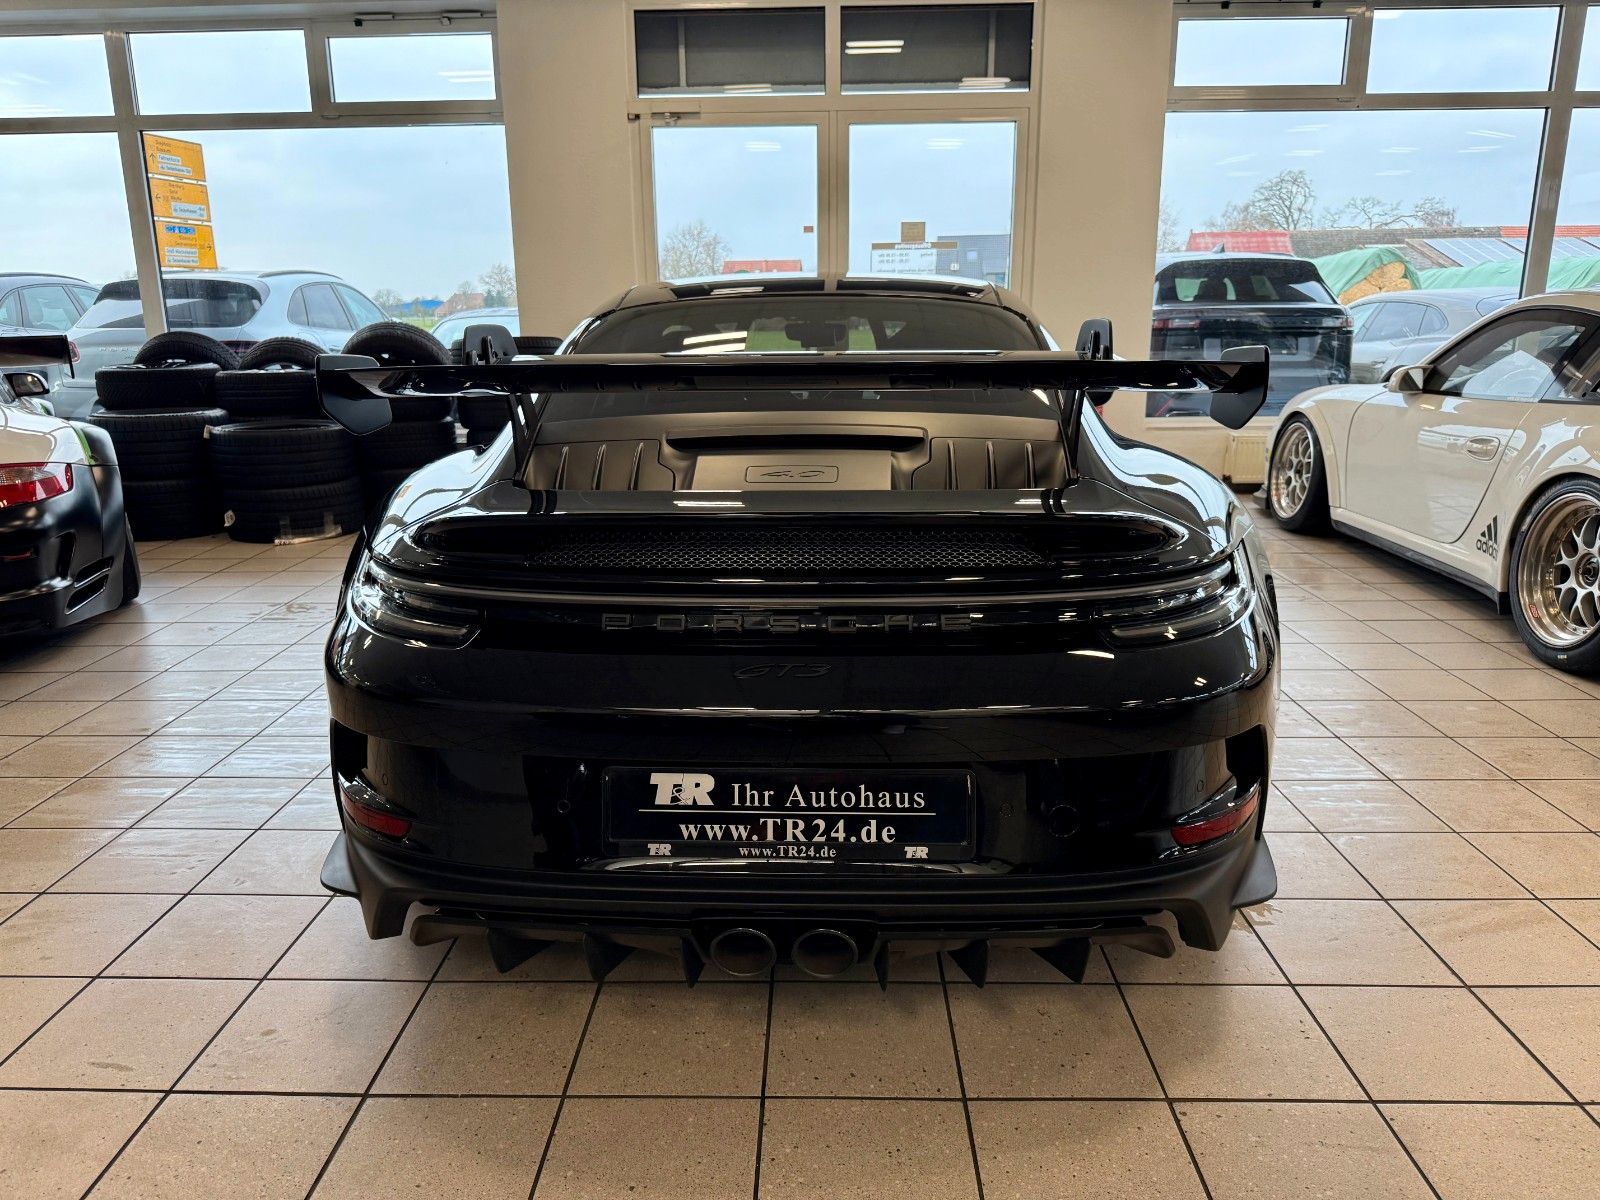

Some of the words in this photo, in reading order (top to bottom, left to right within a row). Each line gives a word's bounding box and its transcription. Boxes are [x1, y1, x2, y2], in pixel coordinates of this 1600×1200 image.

[601, 613, 972, 633] PORSCHE
[733, 663, 833, 679] GT3
[731, 782, 775, 807] Ihr
[784, 783, 926, 808] Autohaus
[678, 818, 897, 843] www.TR24.de
[738, 845, 838, 858] www.TR24.de
